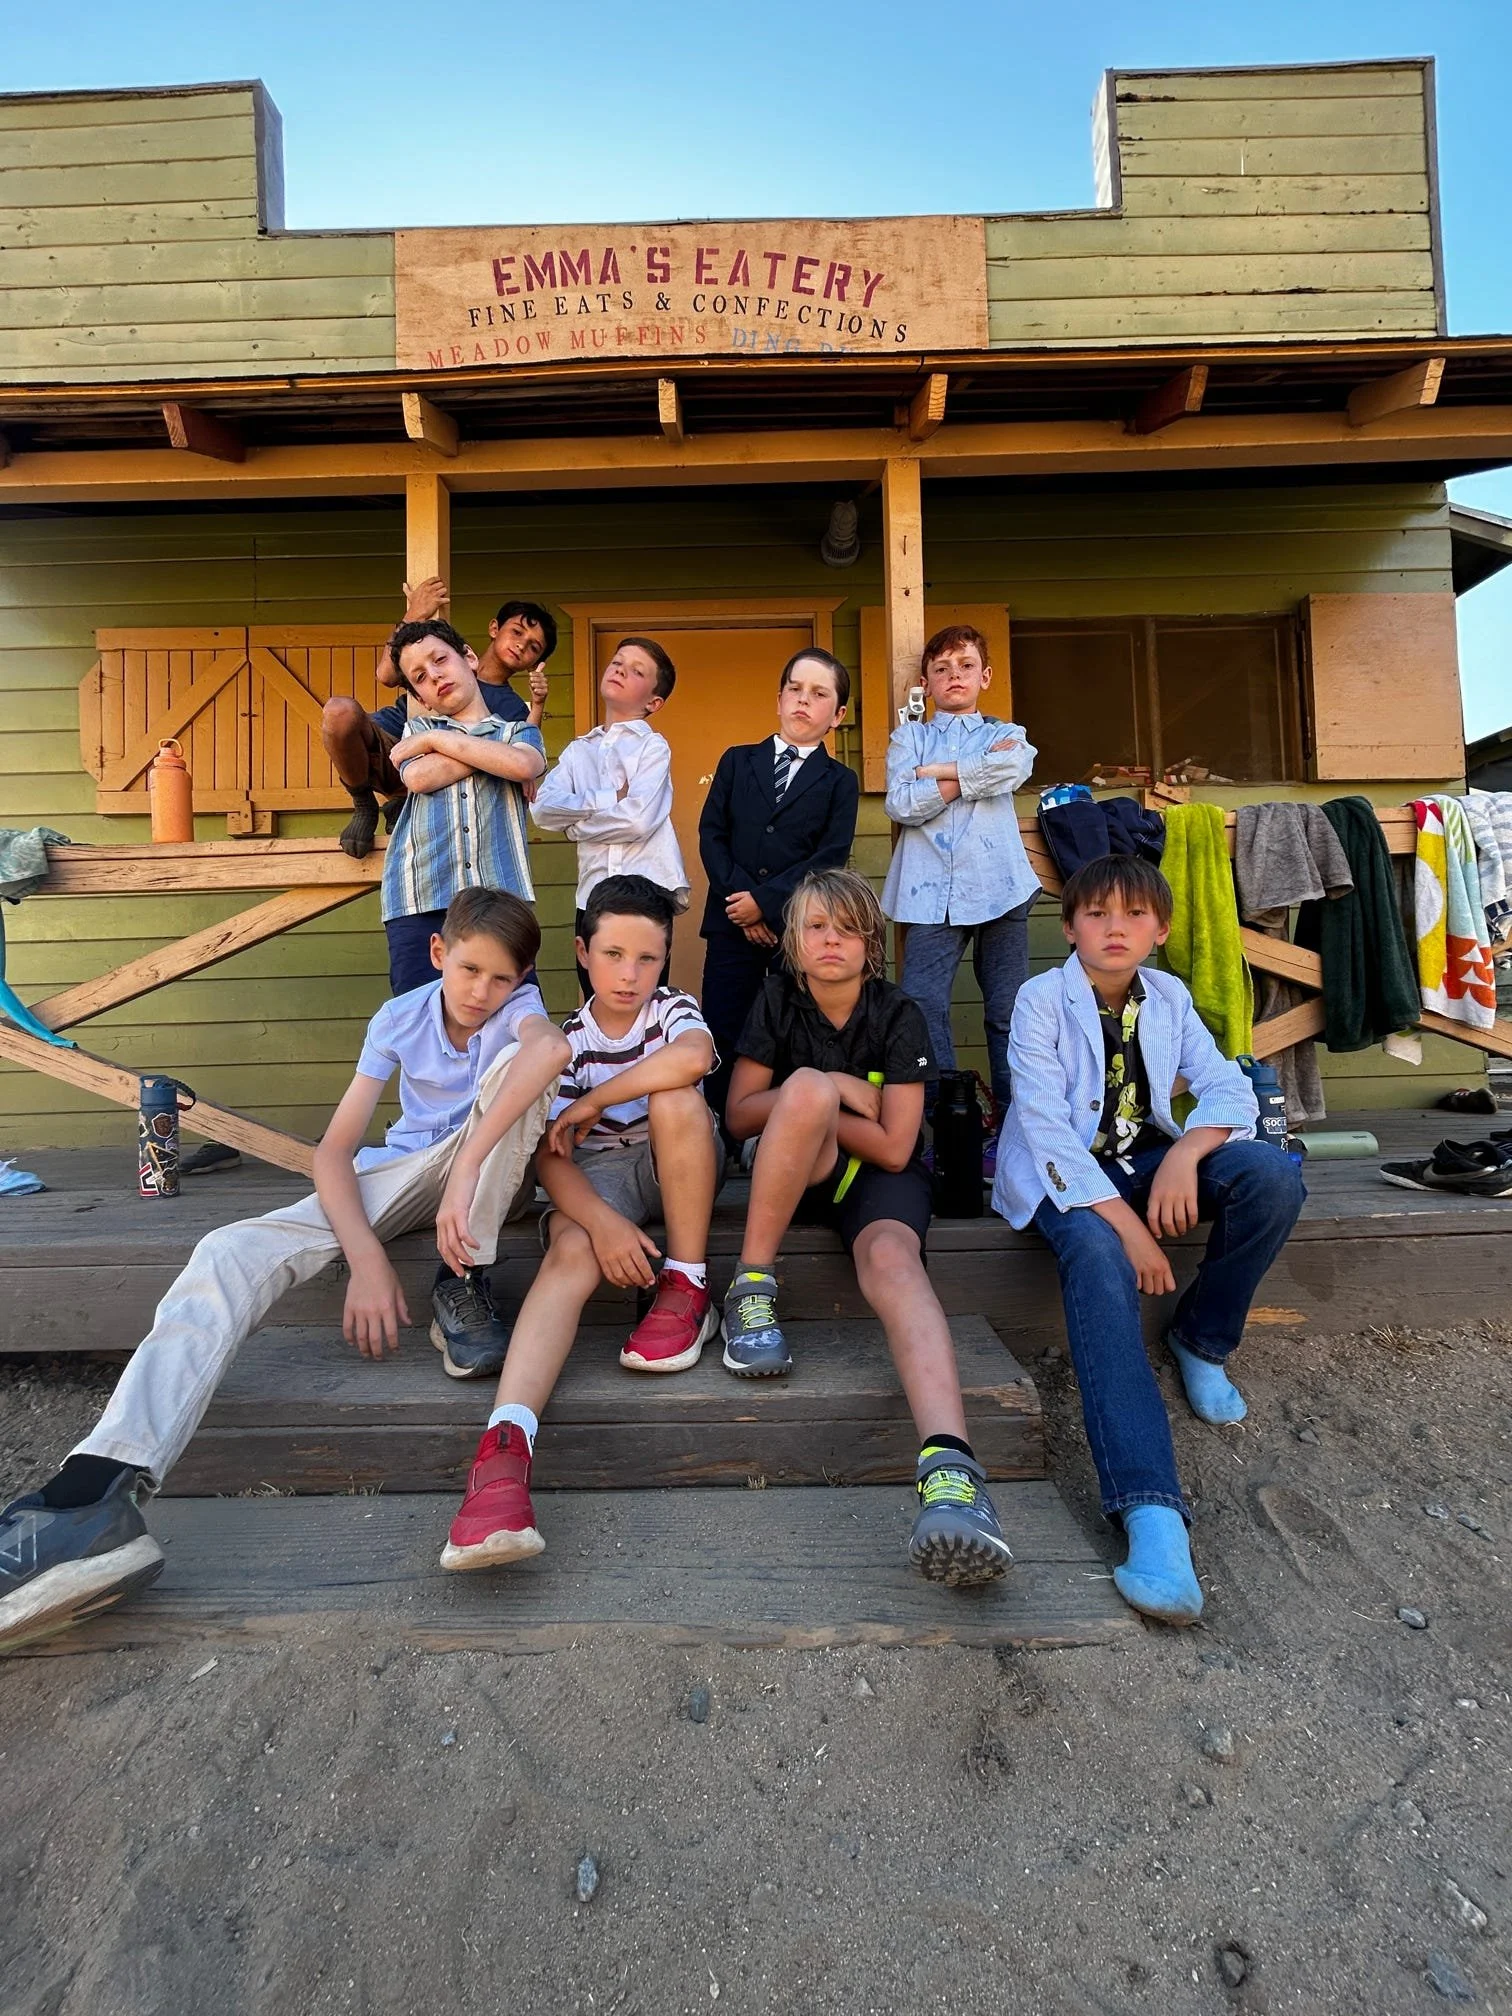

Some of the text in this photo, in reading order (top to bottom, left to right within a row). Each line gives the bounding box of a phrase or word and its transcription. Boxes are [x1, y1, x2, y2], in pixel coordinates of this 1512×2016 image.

[492, 245, 885, 309] EMMA'S EATERY
[468, 290, 907, 343] FINE EATS & CONFECTIONS
[427, 330, 551, 369] MEADOW
[570, 325, 706, 350] MUFFINS
[731, 327, 801, 353] DING
